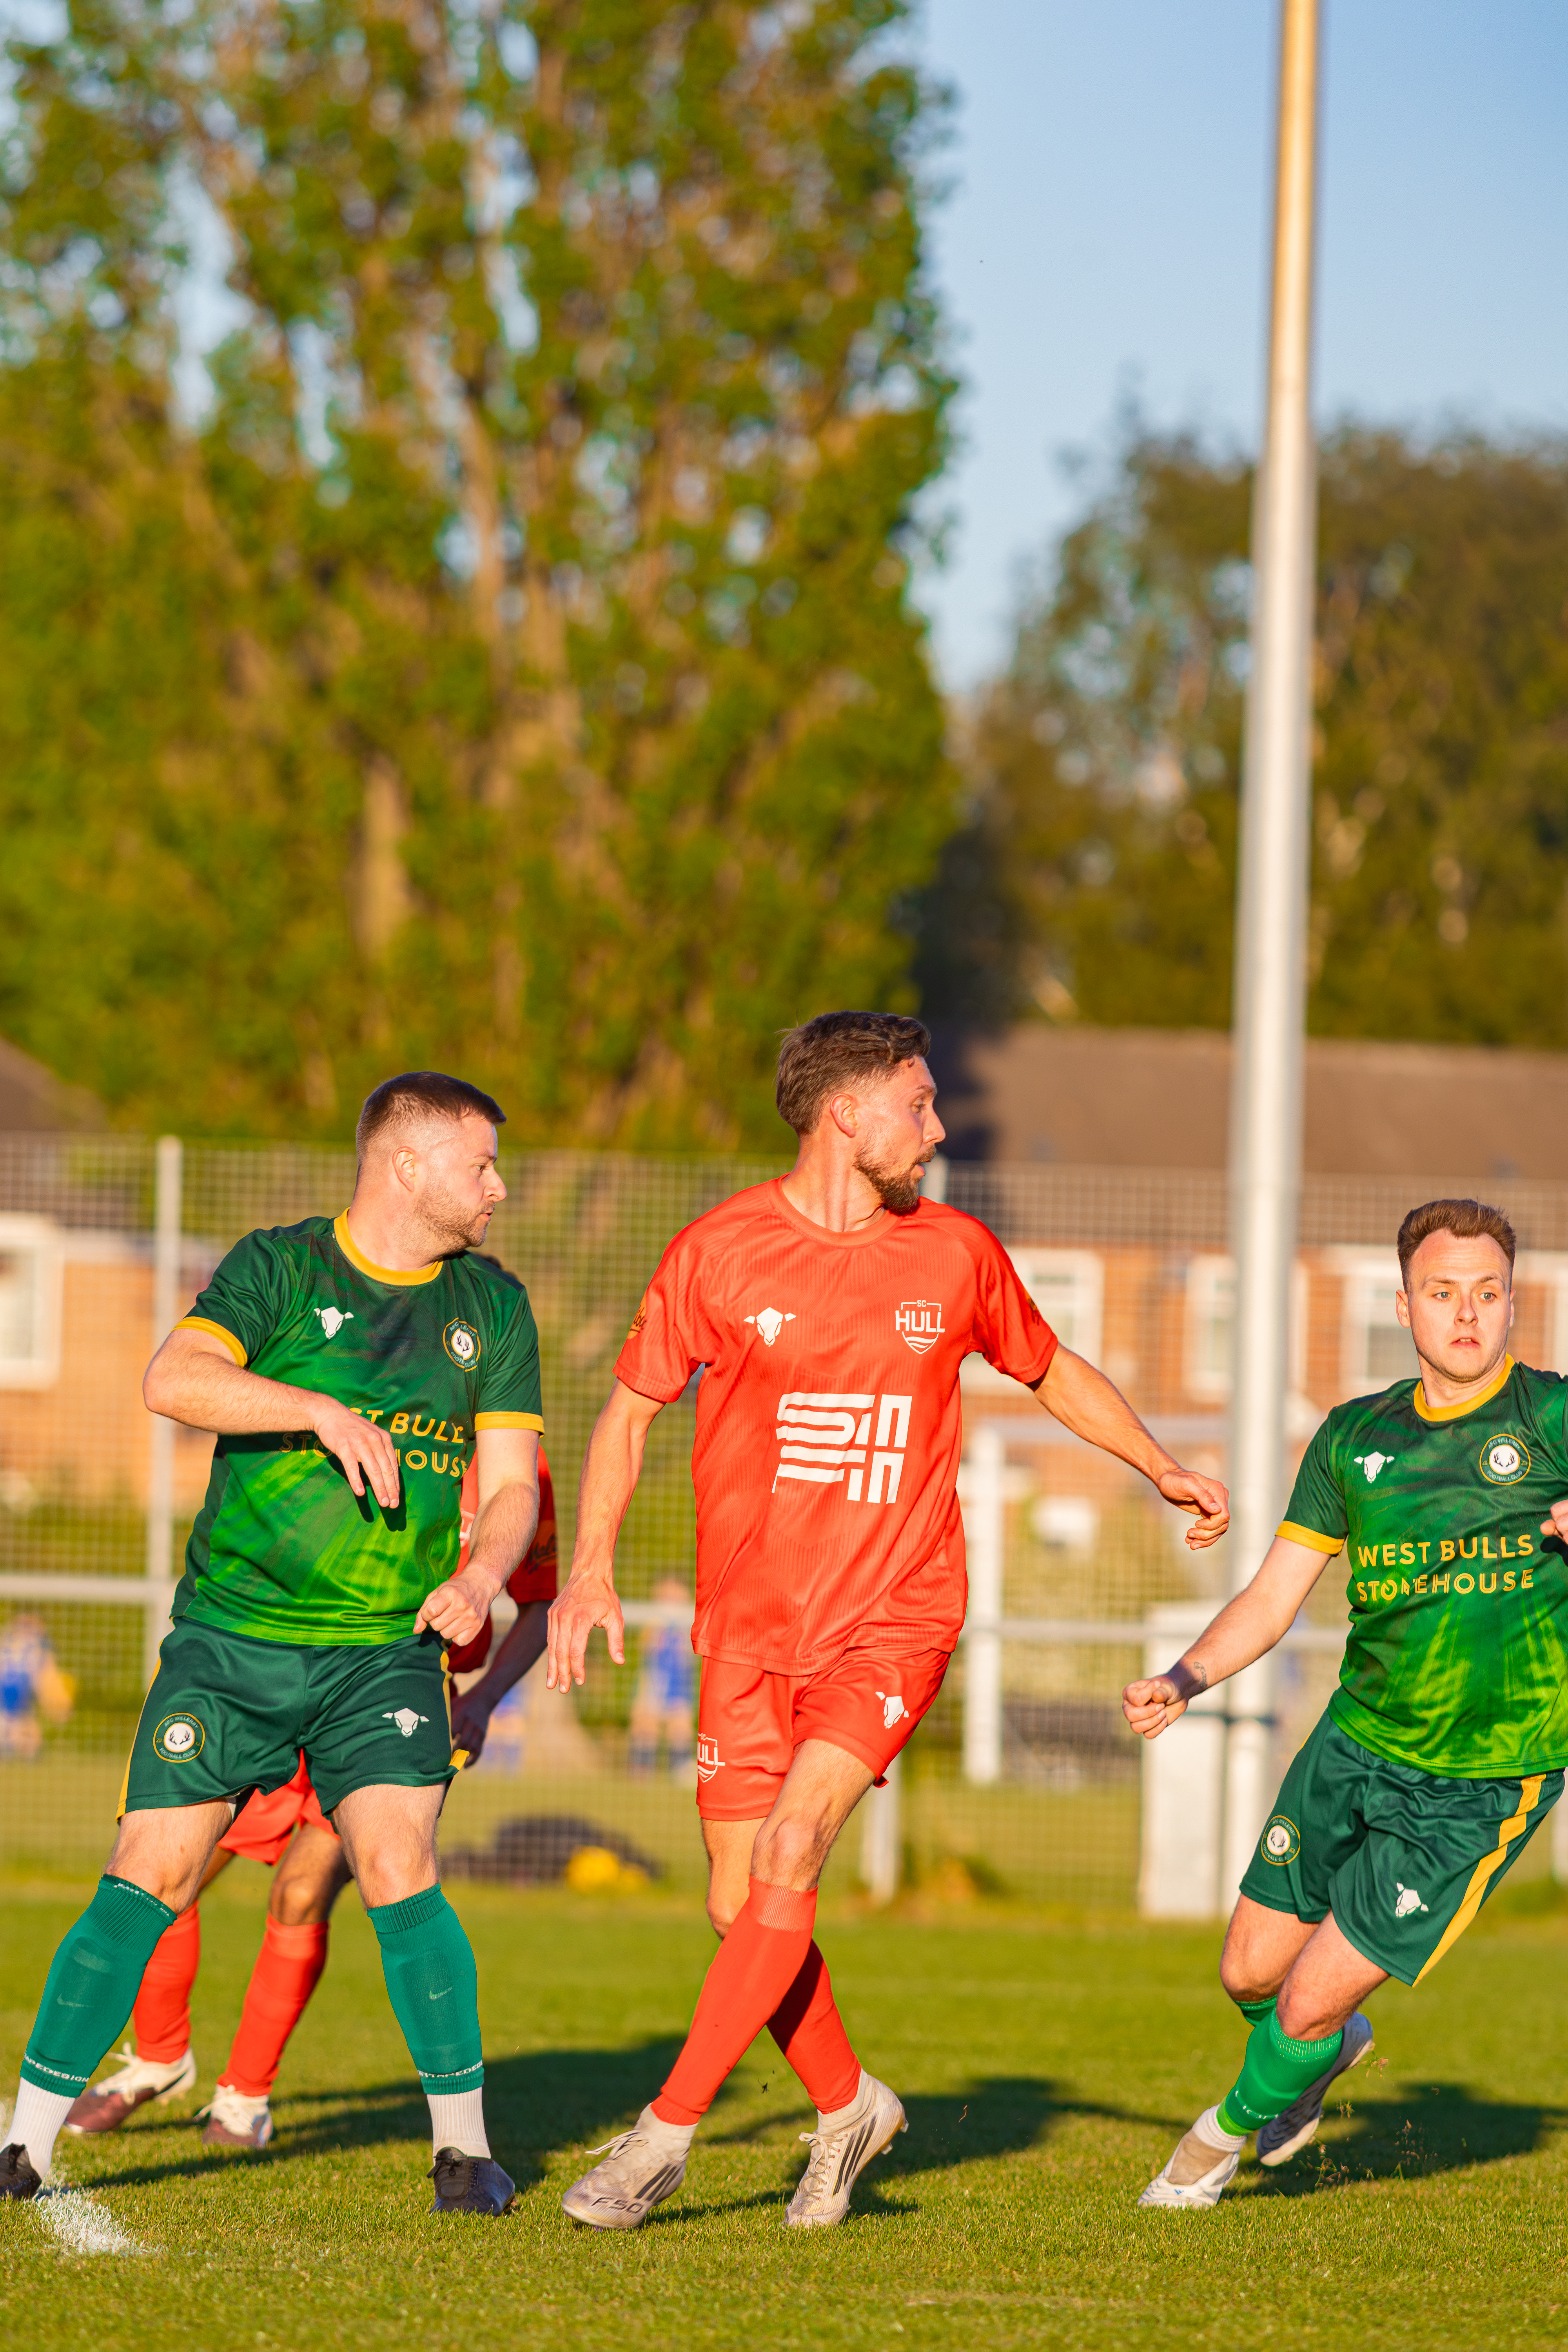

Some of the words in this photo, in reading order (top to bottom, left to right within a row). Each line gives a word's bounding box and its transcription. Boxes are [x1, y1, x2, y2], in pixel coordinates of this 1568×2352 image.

[895, 1310, 945, 1333] HULL
[1357, 1542, 1431, 1567] WEST
[1440, 1534, 1534, 1561] BULLS
[698, 1742, 725, 1766] ULL
[592, 2197, 643, 2214] F50
